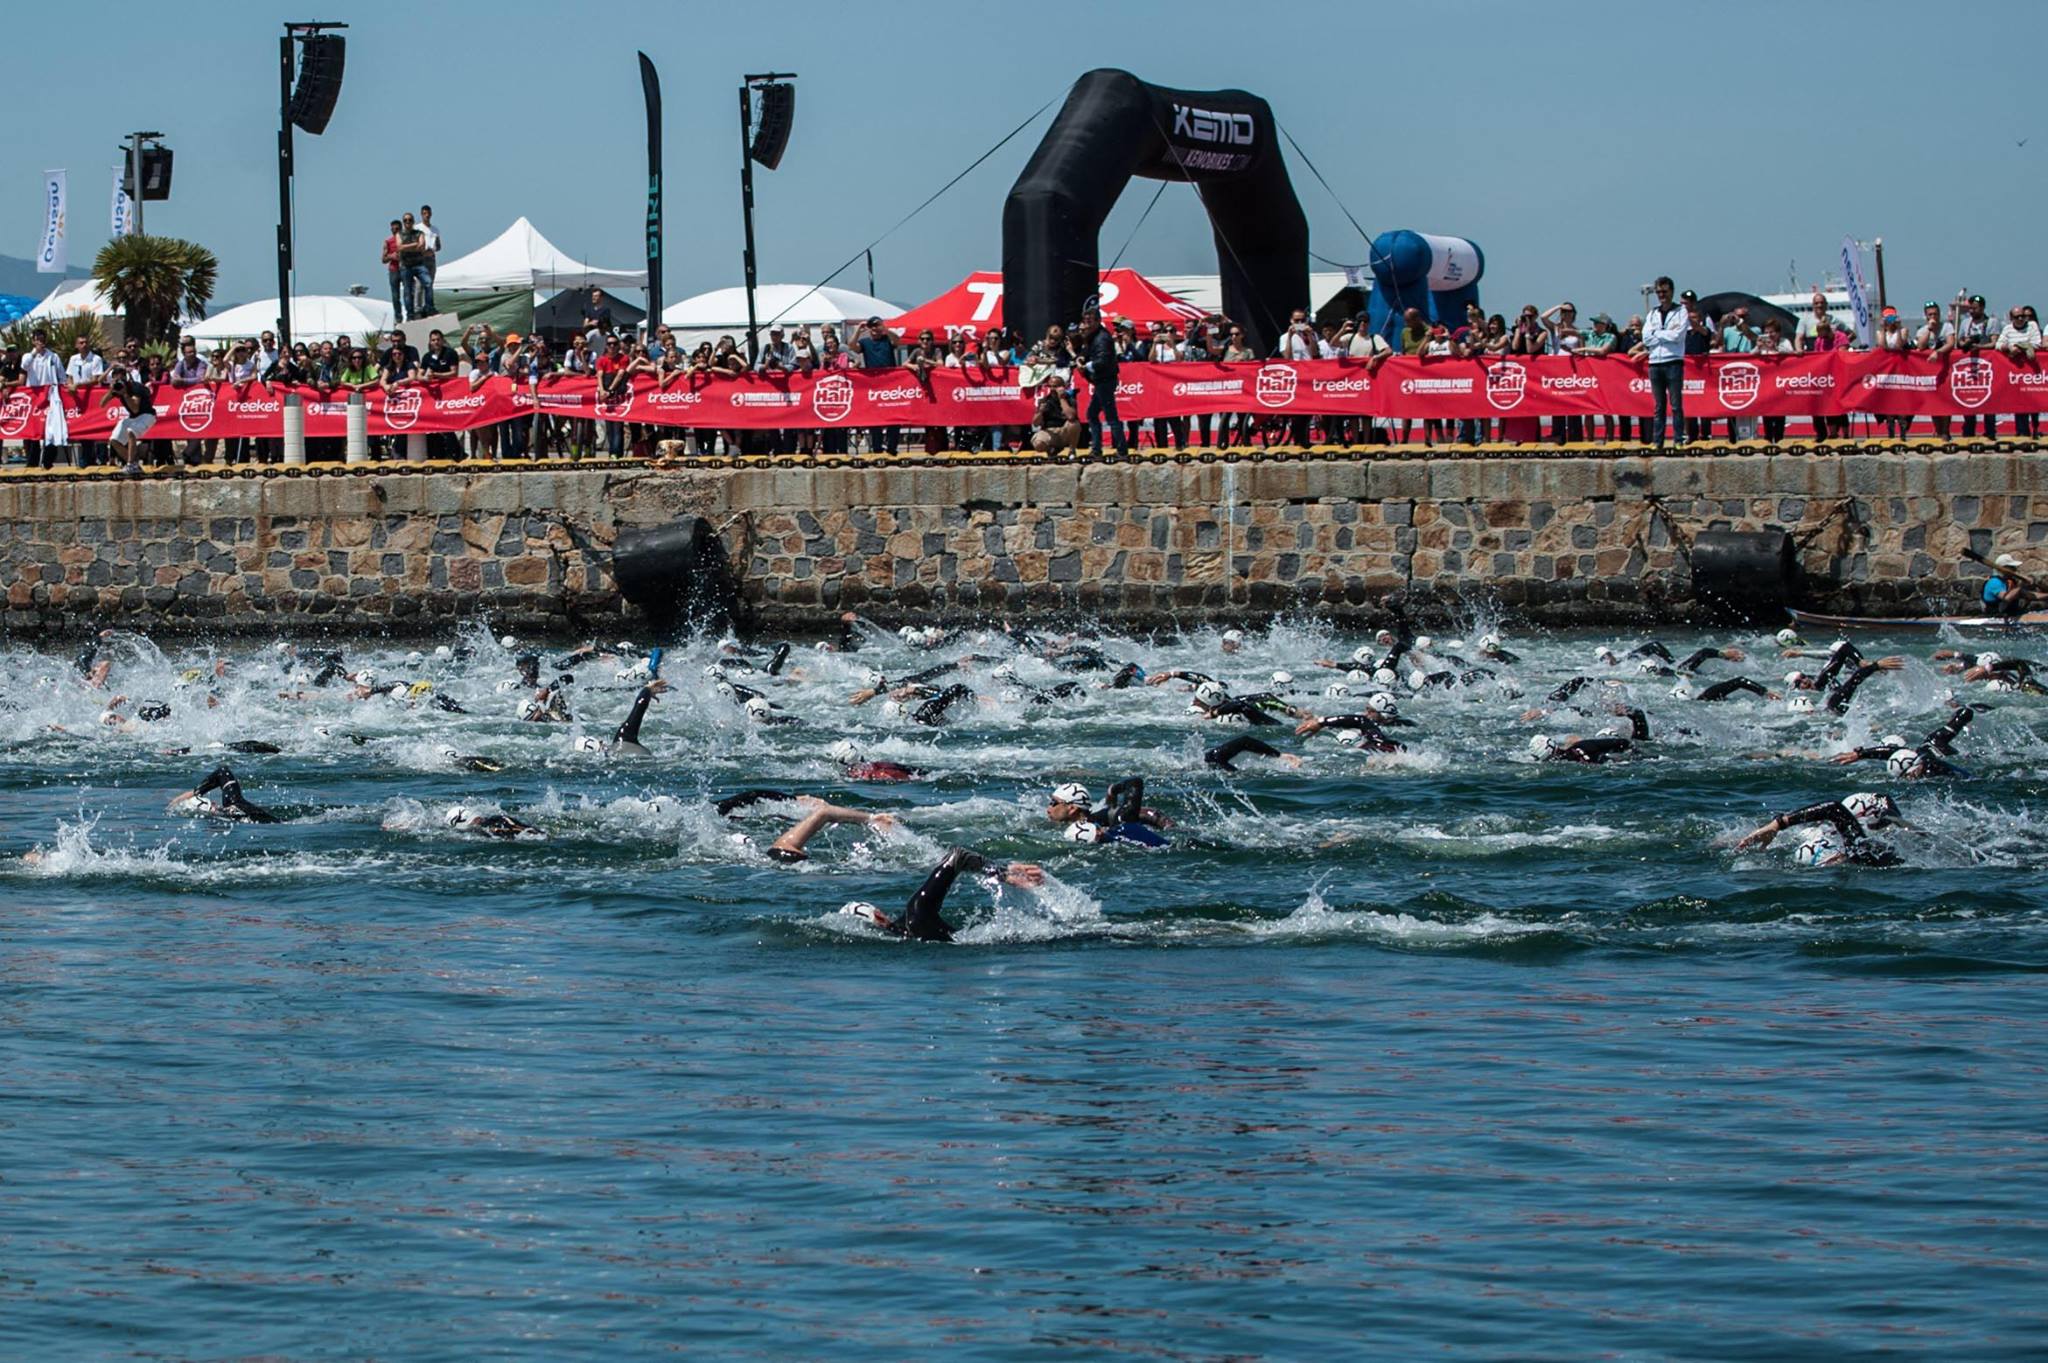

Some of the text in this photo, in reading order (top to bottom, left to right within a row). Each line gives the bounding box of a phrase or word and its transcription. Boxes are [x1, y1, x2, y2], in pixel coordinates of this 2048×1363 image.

[1257, 377, 1297, 392] Half
[1312, 377, 1370, 392] treeket
[1487, 374, 1526, 391] Half
[1541, 373, 1599, 389] treeket
[1719, 375, 1760, 392] Half
[1775, 371, 1836, 388] treeket
[1952, 370, 1994, 388] Half
[648, 390, 702, 404] treeket
[814, 387, 853, 404] Half
[868, 385, 923, 401] treeket
[227, 399, 280, 414] treeket
[434, 393, 486, 410] treeket
